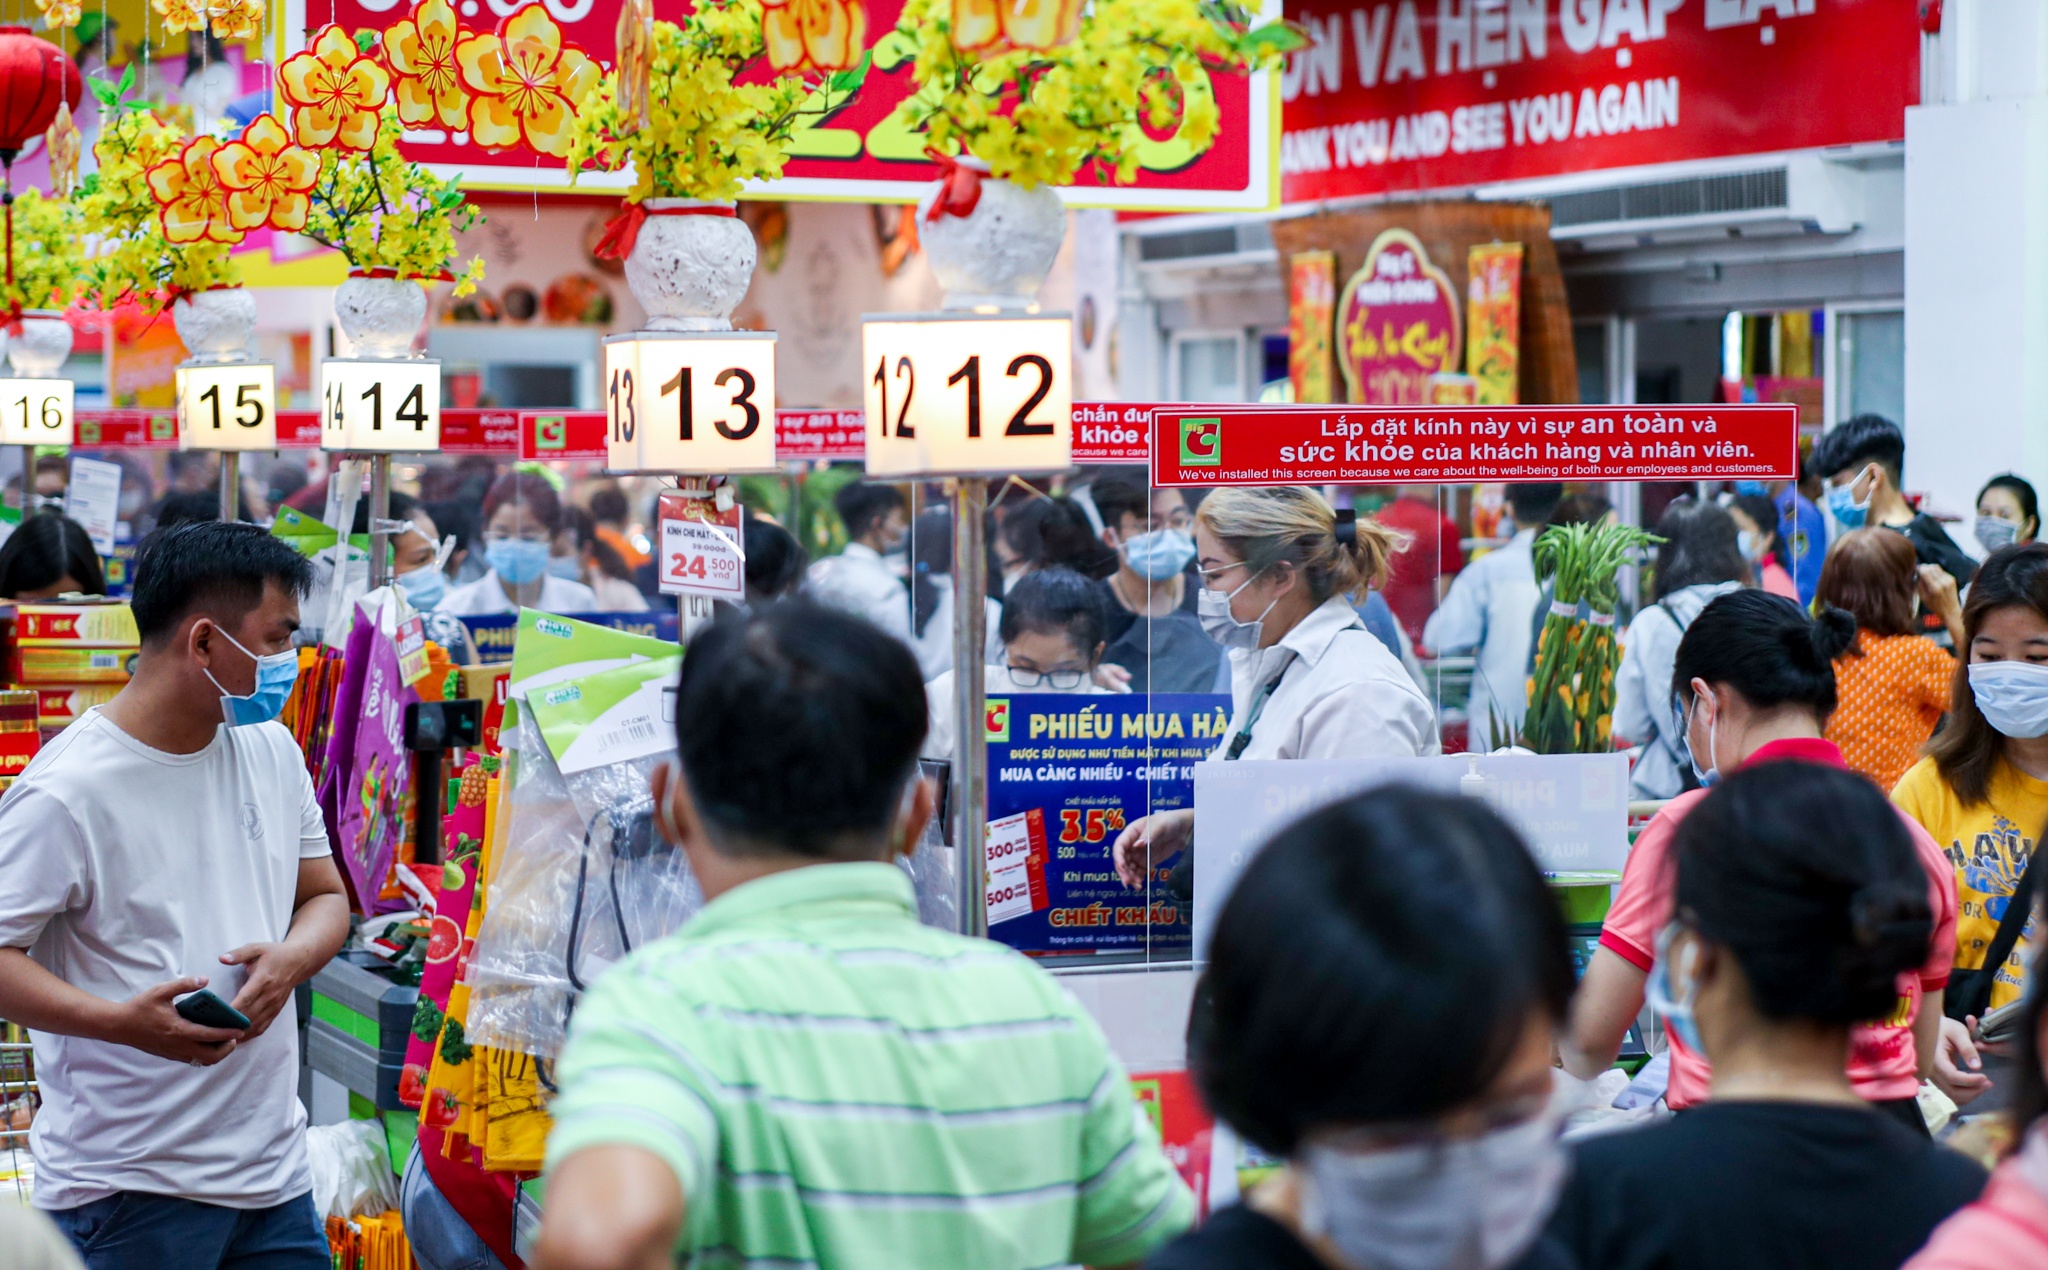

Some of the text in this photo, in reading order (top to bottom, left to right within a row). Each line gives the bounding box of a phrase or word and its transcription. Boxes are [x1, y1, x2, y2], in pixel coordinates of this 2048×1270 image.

[1332, 119, 1390, 169] YOU
[1390, 111, 1450, 161] AND
[1451, 103, 1505, 154] SEE
[1508, 92, 1572, 145] YOU
[1574, 76, 1679, 138] AGAIN
[200, 384, 264, 429] 15
[326, 381, 343, 430] 14
[361, 382, 429, 431] 14
[610, 368, 635, 443] 13
[660, 366, 760, 441] 13
[873, 354, 916, 438] 12
[948, 354, 1055, 438] 12
[14, 396, 62, 429] 16
[1072, 404, 1118, 422] chắn
[1321, 412, 1717, 440] Lắp đặt kính này vì sự an toàn và
[1081, 424, 1138, 444] khỏe
[1185, 423, 1205, 435] Big
[1186, 423, 1219, 457] C
[1071, 448, 1108, 456] ecause
[1280, 436, 1755, 463] sức khỏe của khách hàng và nhân viên.
[1179, 462, 1777, 479] We've installed this screen because we care about the well-being of both our employees and customers.
[683, 528, 695, 538] CHE
[671, 552, 735, 580] 24 .500
[713, 572, 730, 580] vnd
[1029, 703, 1113, 740] PHIẾU
[1121, 713, 1185, 738] MUA
[1010, 747, 1039, 760] ĐƯỢC
[1042, 746, 1056, 758] SỬ
[1058, 748, 1086, 761] DỤNG
[1089, 747, 1110, 758] NHƯ
[1162, 748, 1178, 758] KHI
[1181, 748, 1202, 758] MUA
[1001, 768, 1032, 781] MUA
[1036, 764, 1076, 780] CÀNG
[1080, 762, 1123, 780] NHIỀU
[1136, 761, 1178, 780] CHIẾT
[1059, 808, 1126, 843] 3.5%
[987, 841, 1013, 861] 300
[1057, 846, 1110, 859] 500 2
[1063, 871, 1080, 882] Khi
[1083, 873, 1109, 882] mua
[987, 886, 1013, 907] 500
[1049, 901, 1112, 928] CHIẾT
[1115, 901, 1178, 926] KHẤU
